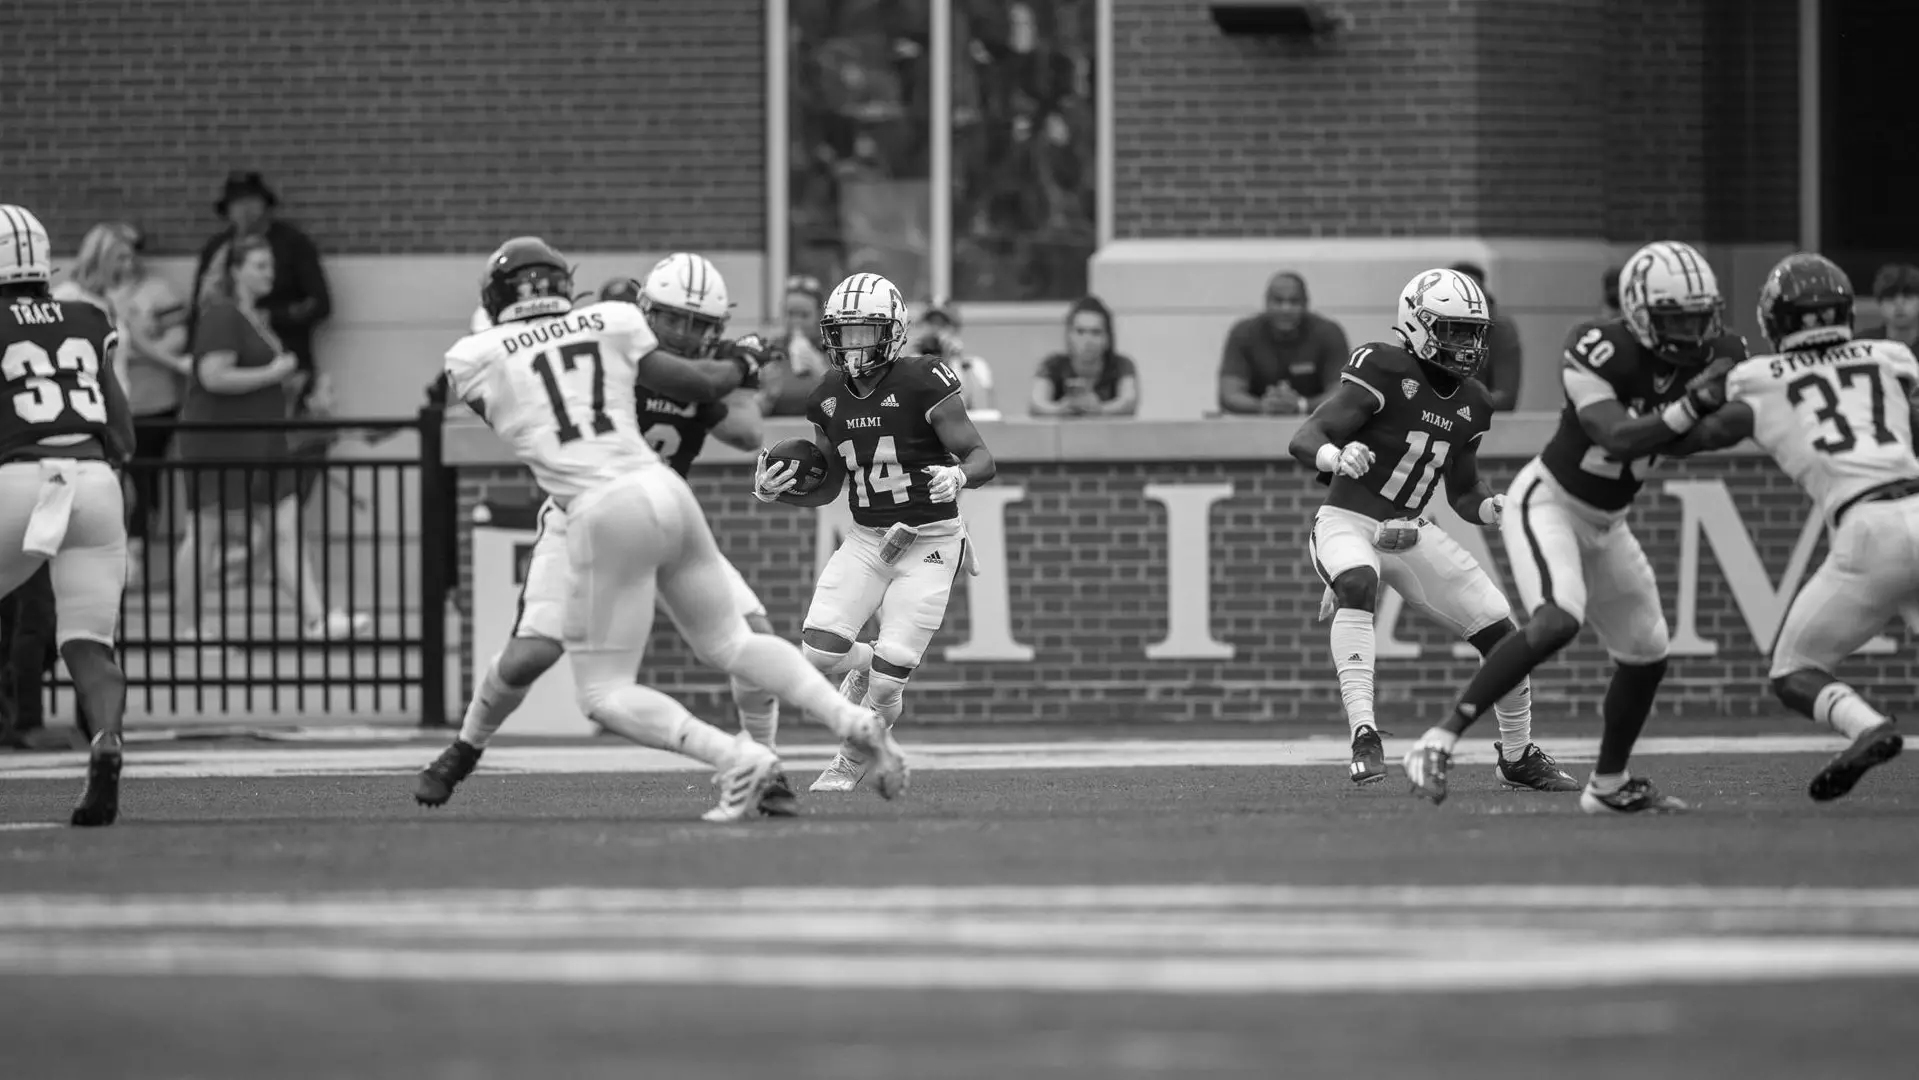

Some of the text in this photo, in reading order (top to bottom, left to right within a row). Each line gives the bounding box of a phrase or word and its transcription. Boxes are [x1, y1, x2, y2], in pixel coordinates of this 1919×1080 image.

[9, 302, 64, 325] TRACY
[503, 313, 605, 354] DOUGLAS
[1349, 348, 1374, 369] 11
[1576, 328, 1615, 368] 20
[1, 337, 108, 424] 33
[531, 341, 616, 444] 17
[931, 361, 957, 387] 14
[846, 416, 882, 430] MIAMI
[1421, 410, 1454, 432] MIAMI
[1786, 363, 1900, 456] 37
[837, 435, 913, 508] 14
[1379, 431, 1451, 510] 11
[923, 557, 944, 565] adidas
